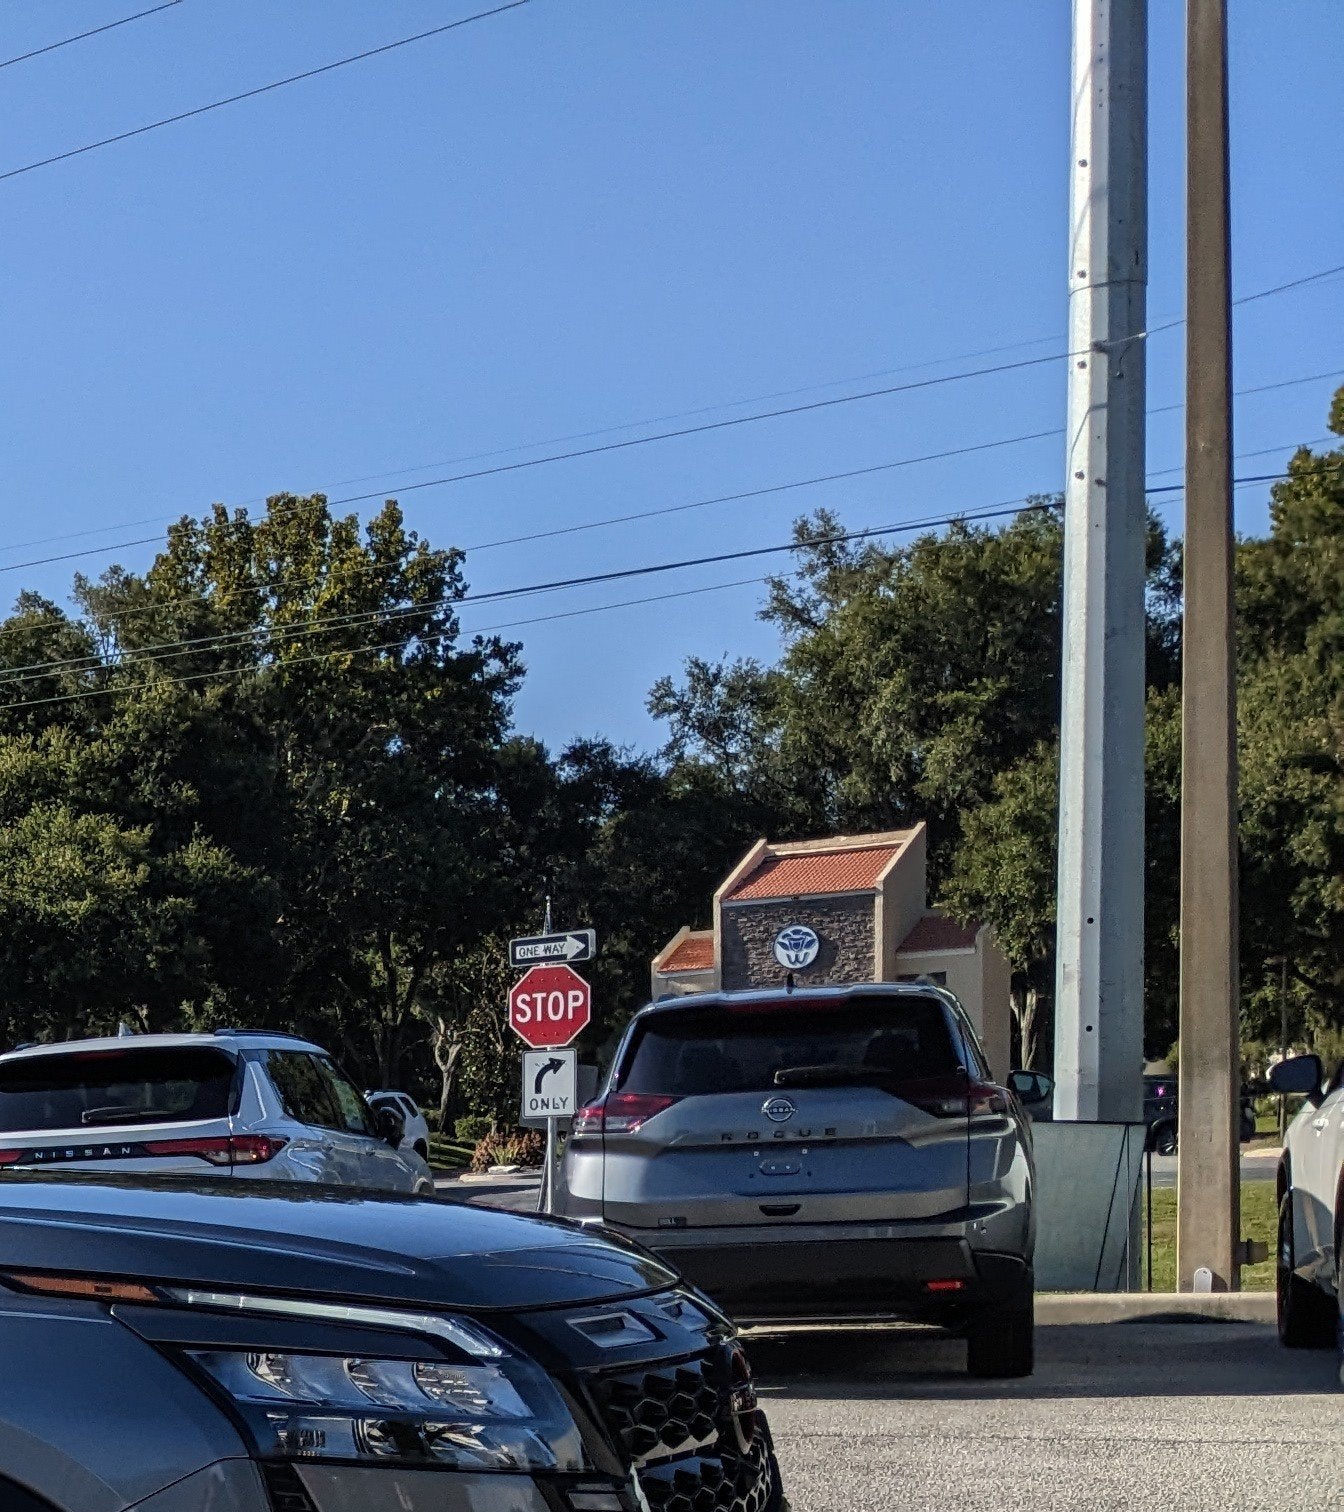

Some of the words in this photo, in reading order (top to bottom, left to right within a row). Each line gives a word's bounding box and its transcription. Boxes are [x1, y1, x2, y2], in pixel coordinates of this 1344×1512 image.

[518, 946, 540, 958] ONE
[543, 943, 566, 955] WAY
[515, 990, 584, 1023] STOP
[529, 1096, 569, 1111] ONLY
[721, 1127, 837, 1141] ROGUE
[34, 1147, 131, 1159] NISSAN
